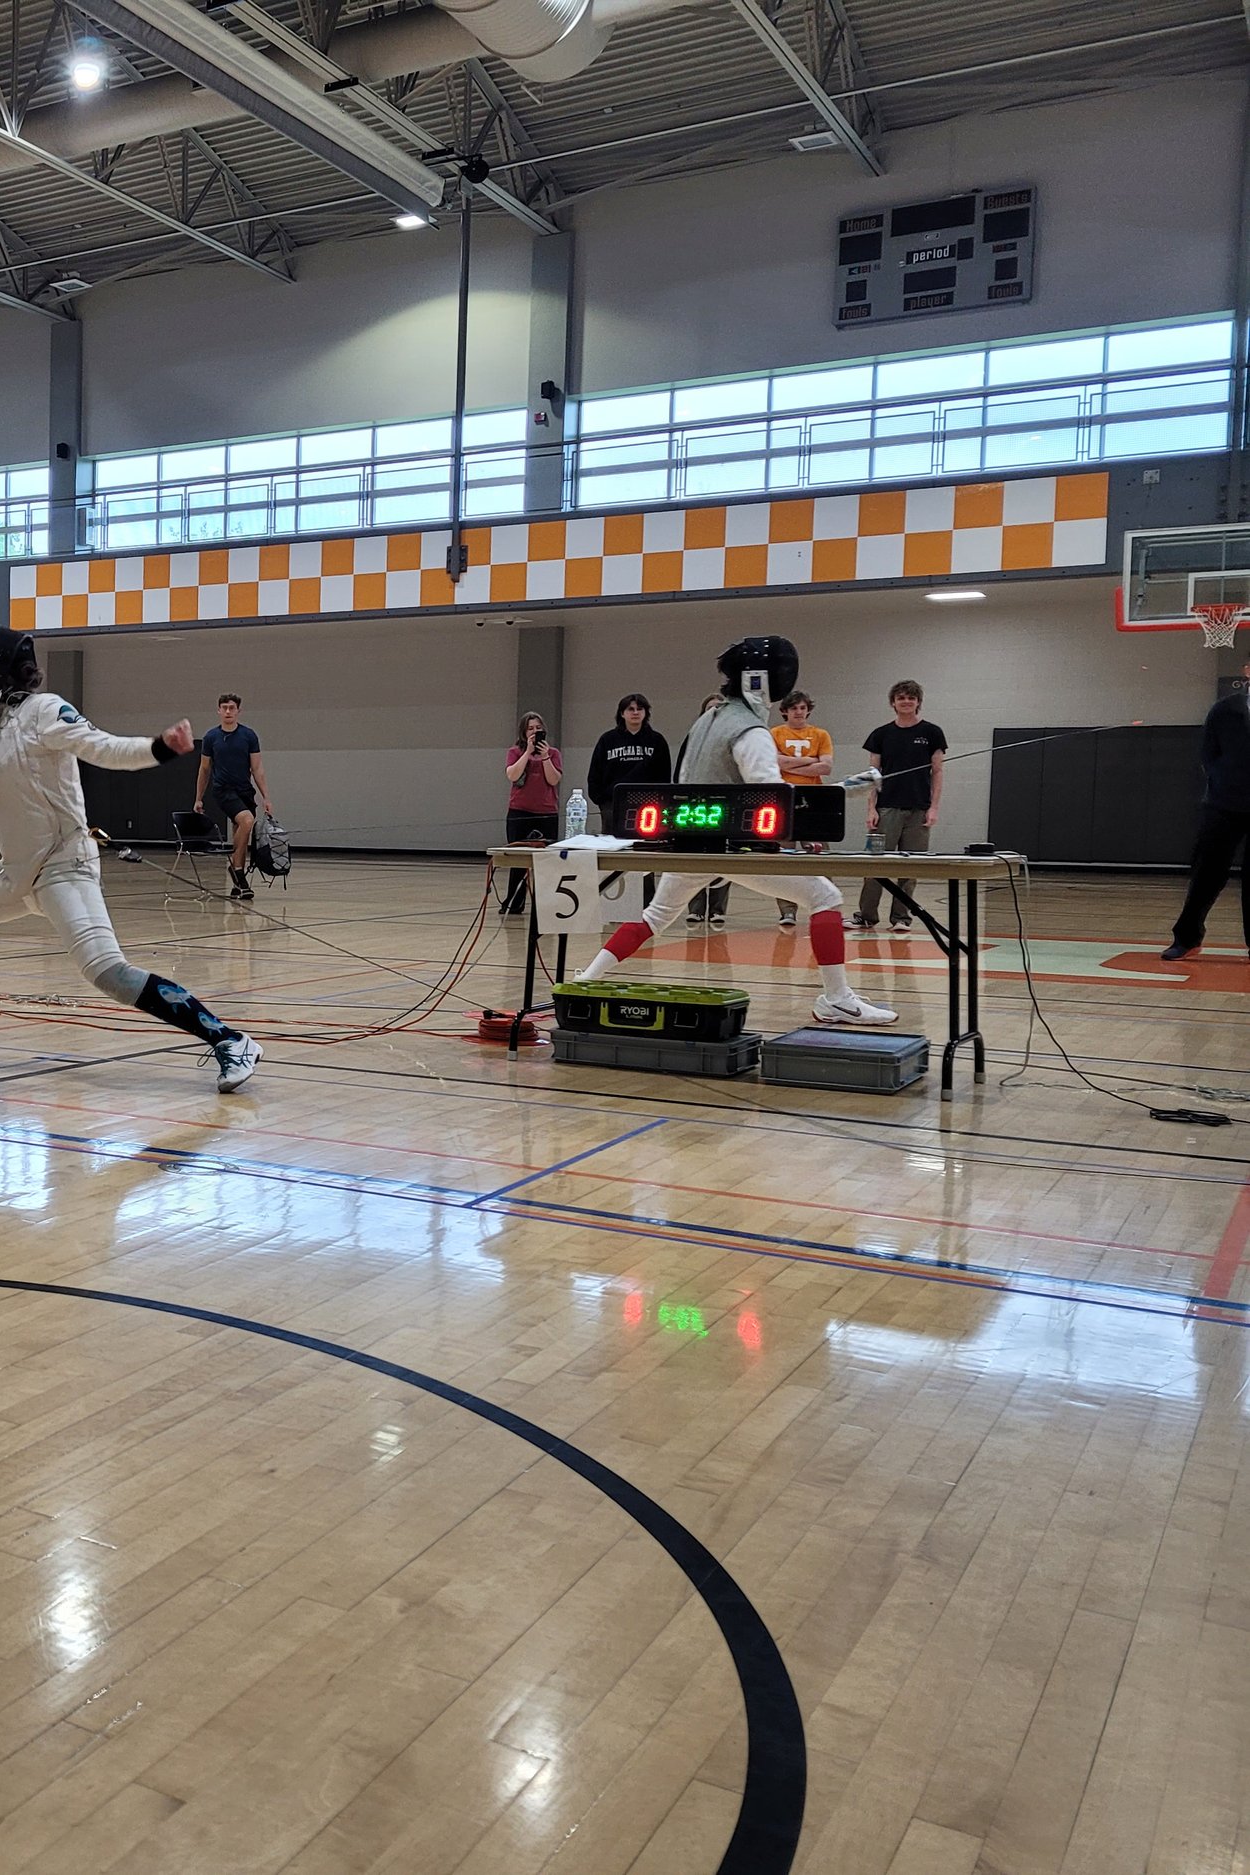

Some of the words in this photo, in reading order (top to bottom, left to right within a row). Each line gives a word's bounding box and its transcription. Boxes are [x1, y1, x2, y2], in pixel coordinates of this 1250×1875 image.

[987, 192, 1028, 208] Guests
[846, 218, 877, 232] Home
[912, 244, 950, 264] period
[910, 293, 947, 311] player
[842, 305, 869, 320] fouls
[785, 739, 810, 757] T
[639, 805, 658, 834] 0
[675, 804, 722, 825] 2:52
[756, 805, 777, 835] 0
[555, 875, 579, 919] 5
[619, 1005, 650, 1016] RYOBI
